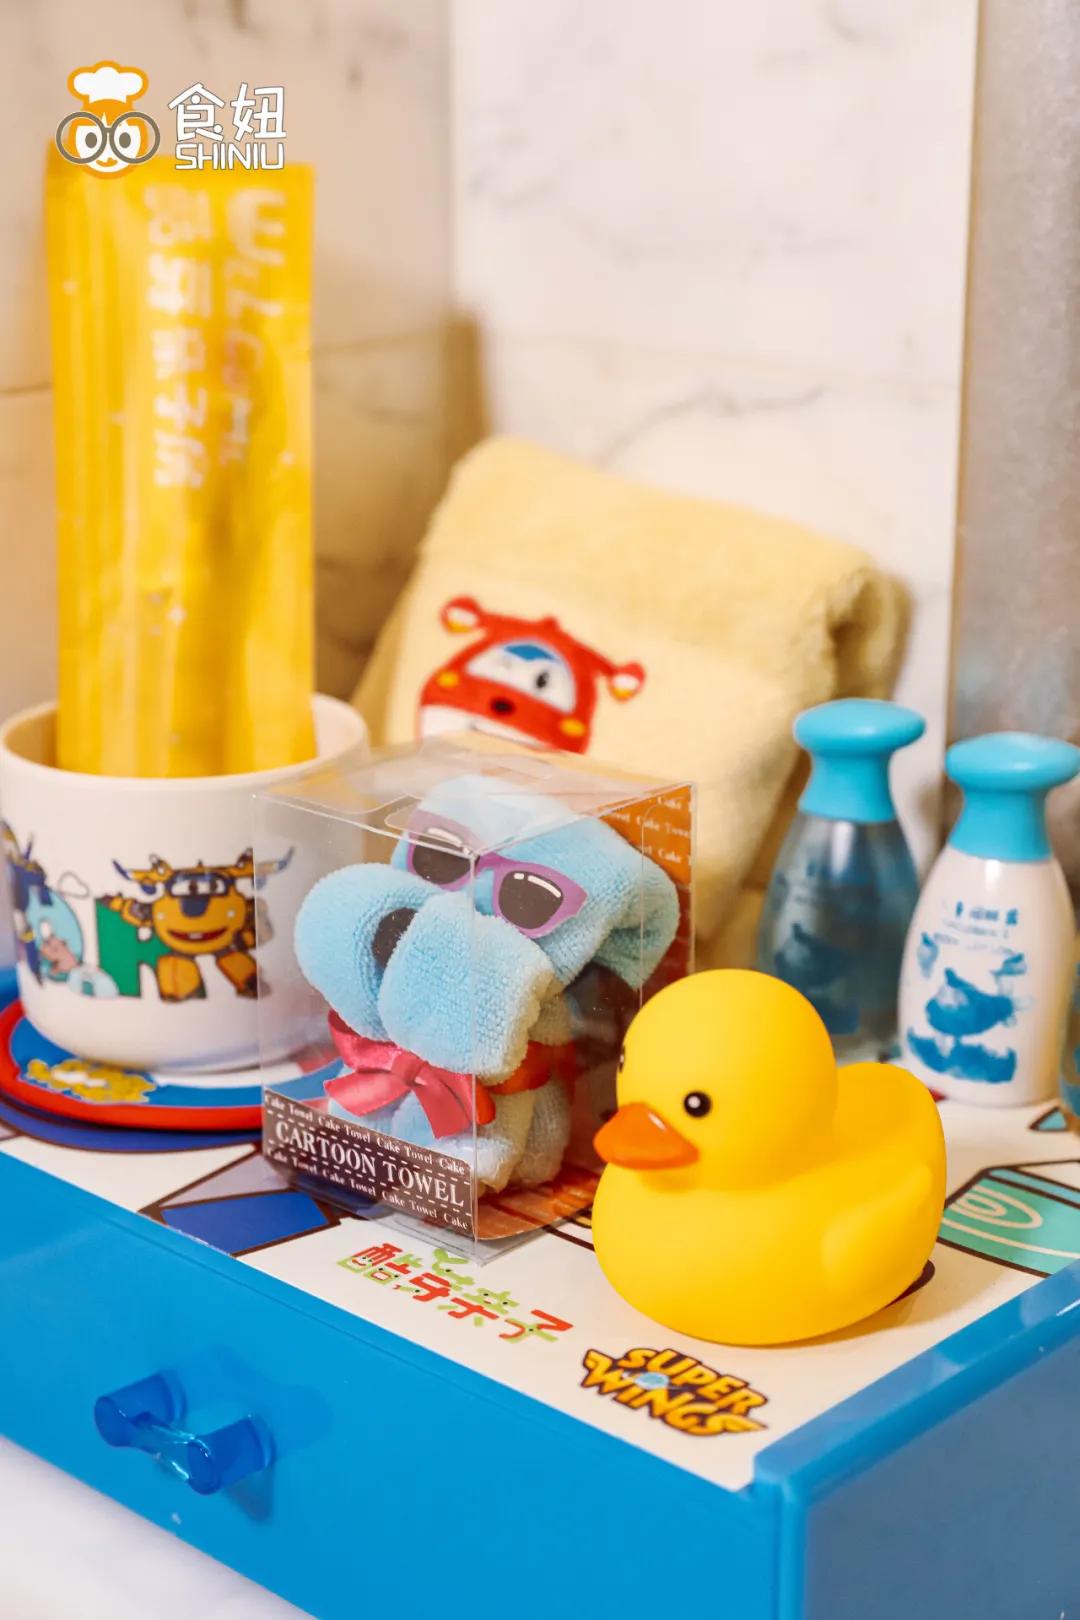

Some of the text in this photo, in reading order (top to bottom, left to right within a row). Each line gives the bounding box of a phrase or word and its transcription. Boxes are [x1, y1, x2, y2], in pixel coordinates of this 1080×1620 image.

[275, 1121, 465, 1208] CARTOON TOWEL
[318, 1115, 340, 1132] Cake
[344, 1124, 371, 1143] Towel
[376, 1137, 400, 1154] Cake
[403, 1145, 433, 1165] Towel
[438, 1157, 465, 1175] Cake
[322, 1168, 347, 1187] Cake
[349, 1177, 377, 1198] Towel
[381, 1190, 406, 1206] Cake
[409, 1199, 438, 1219] Towel
[443, 1212, 469, 1230] Cake
[580, 1347, 769, 1437] WINGS
[616, 1347, 769, 1416] SUPER
